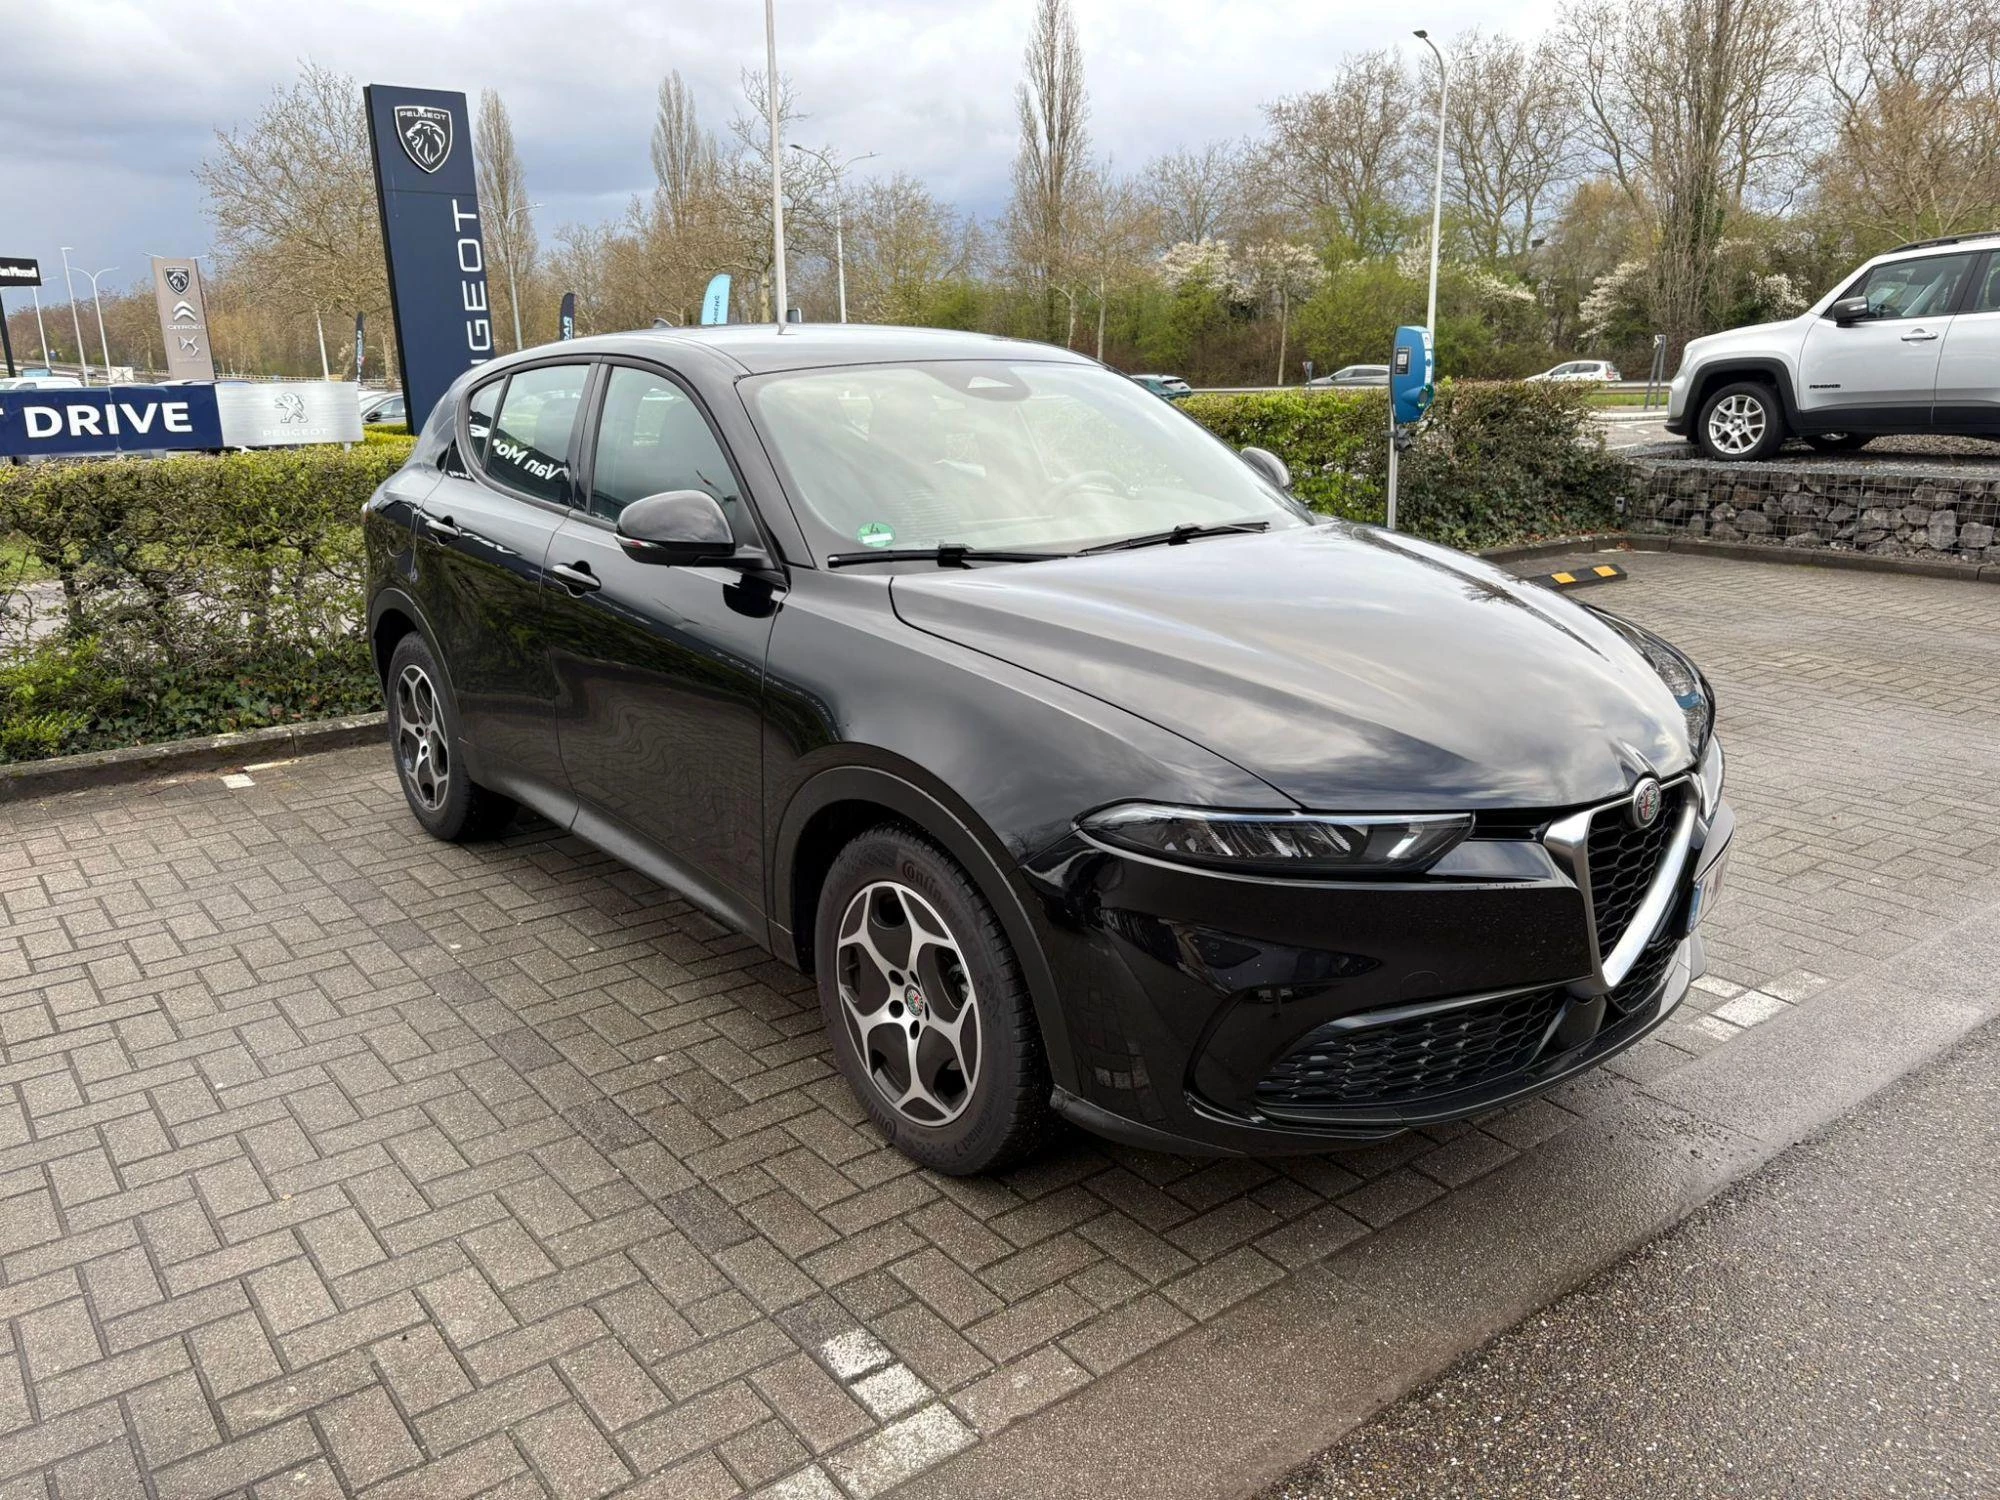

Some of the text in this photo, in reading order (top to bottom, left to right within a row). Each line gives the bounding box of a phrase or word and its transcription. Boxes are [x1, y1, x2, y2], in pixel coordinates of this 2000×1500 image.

[399, 109, 447, 120] PEUGEOT
[0, 266, 10, 277] an
[452, 198, 492, 365] GEOT
[23, 401, 193, 439] DRIVE
[263, 428, 329, 438] PEUGEOT
